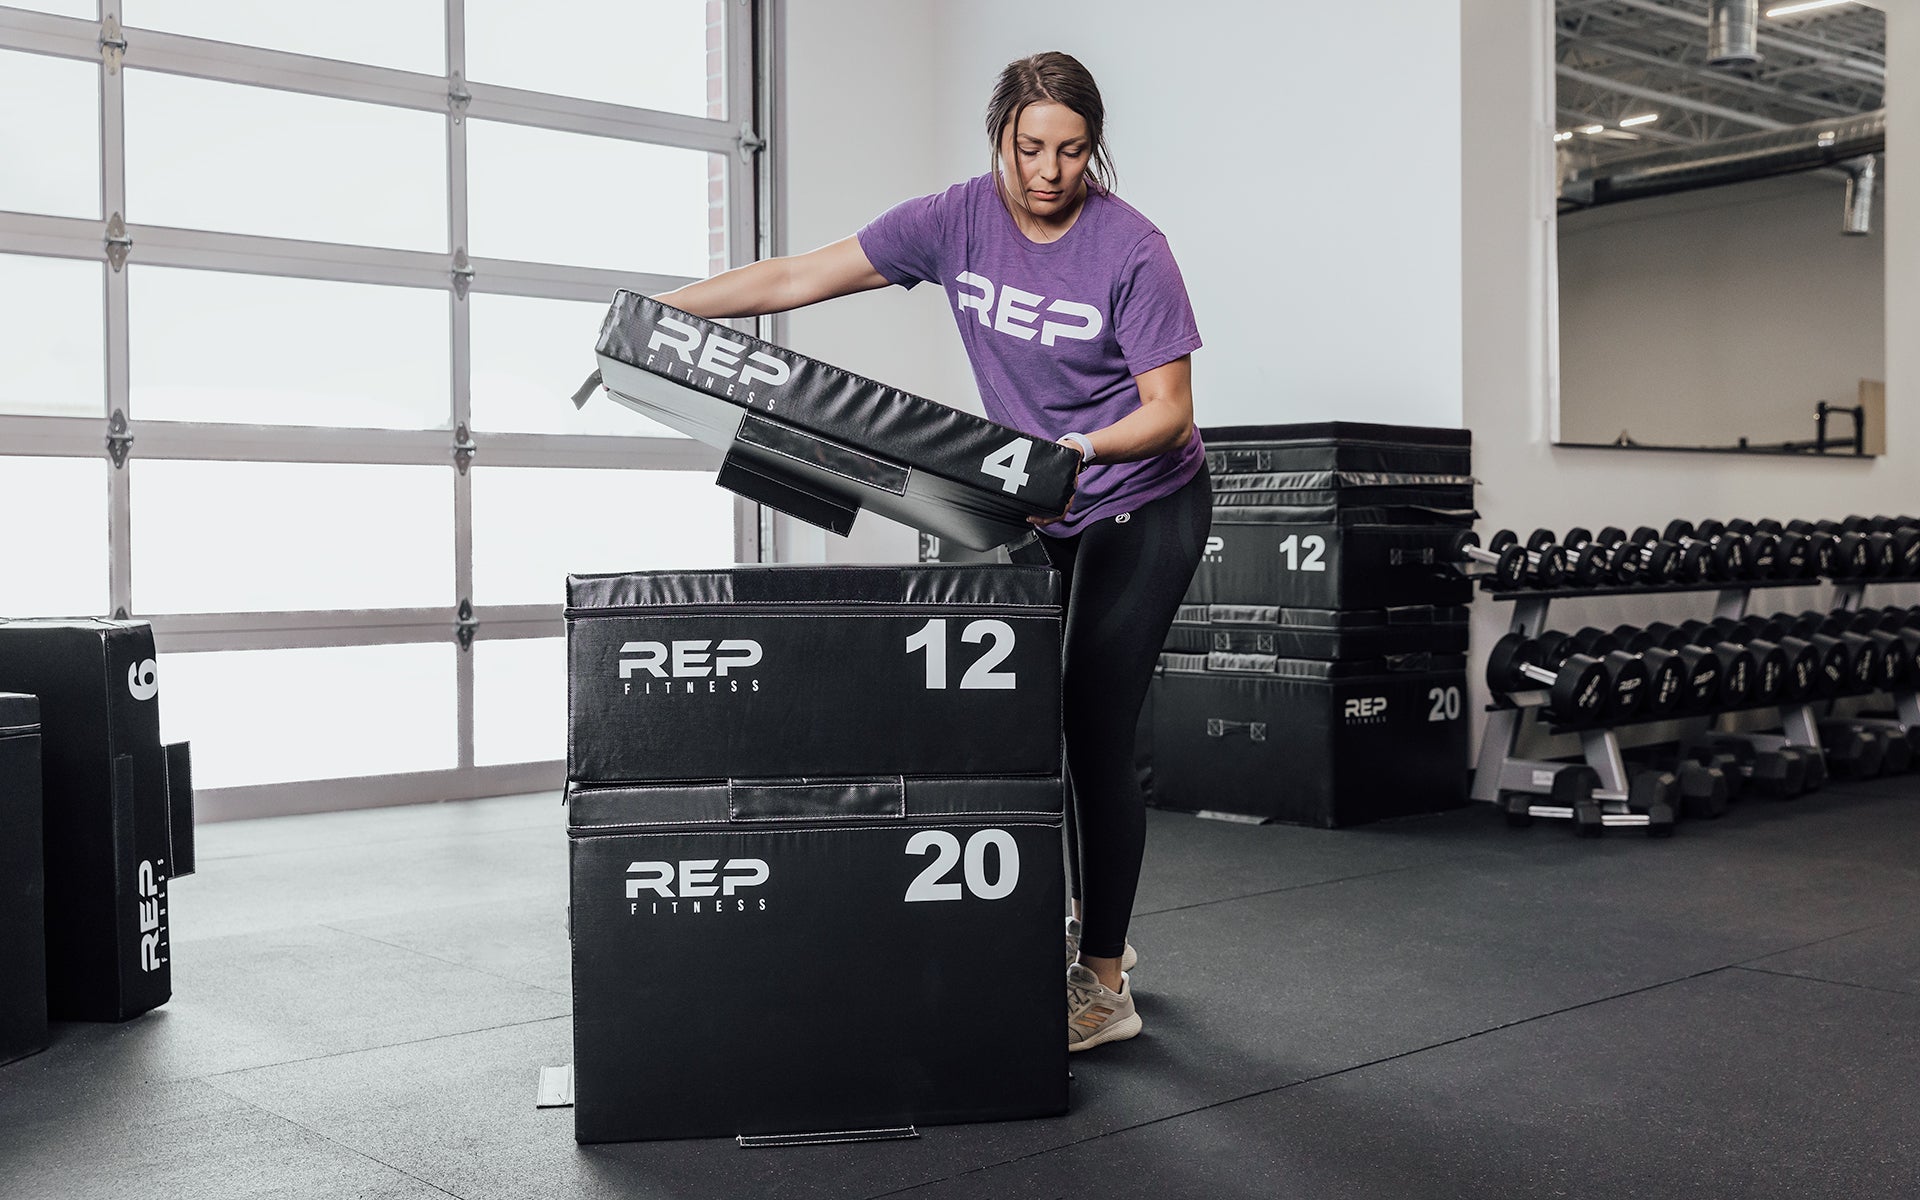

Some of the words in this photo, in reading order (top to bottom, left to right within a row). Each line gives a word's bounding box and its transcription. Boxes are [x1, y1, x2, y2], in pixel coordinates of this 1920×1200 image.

[955, 270, 1103, 347] REP
[648, 316, 791, 386] REP
[646, 354, 776, 411] FITNESS
[980, 437, 1031, 494] 4
[1279, 534, 1326, 572] 12
[618, 639, 763, 679] REP
[905, 617, 1018, 690] 12
[128, 658, 158, 701] 6
[624, 679, 760, 695] FITNESS
[1428, 686, 1460, 722] 20
[1345, 697, 1387, 718] REP
[625, 858, 770, 899] REP
[904, 829, 1021, 903] 20
[139, 859, 160, 973] REP
[157, 857, 168, 963] FITNESS
[630, 898, 767, 915] FITNESS
